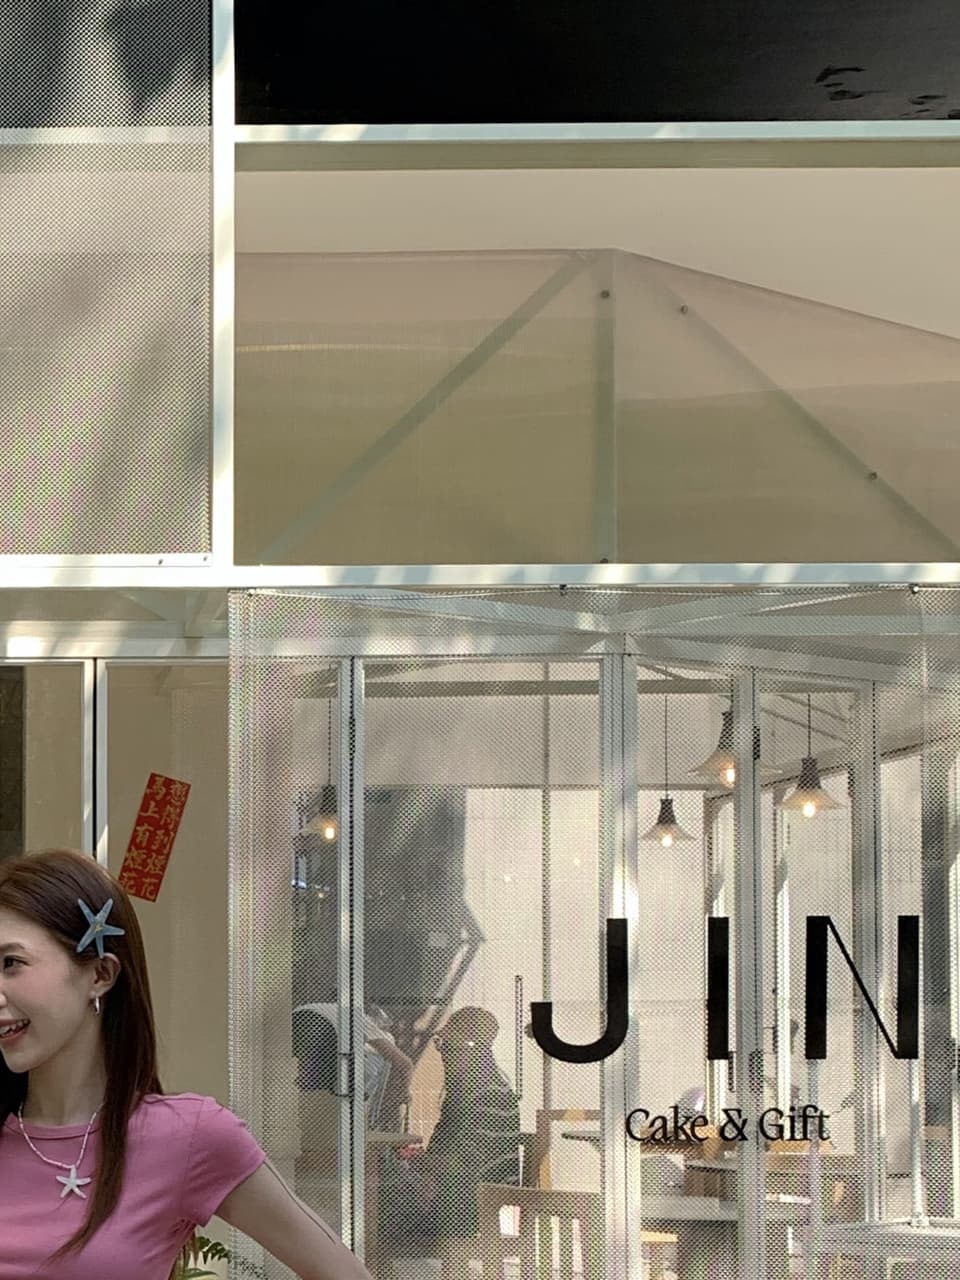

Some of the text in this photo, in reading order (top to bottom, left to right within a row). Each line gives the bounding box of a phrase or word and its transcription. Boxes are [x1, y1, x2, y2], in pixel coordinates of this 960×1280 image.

[530, 915, 919, 1063] JIN
[625, 1104, 831, 1142] Cake & Gift
